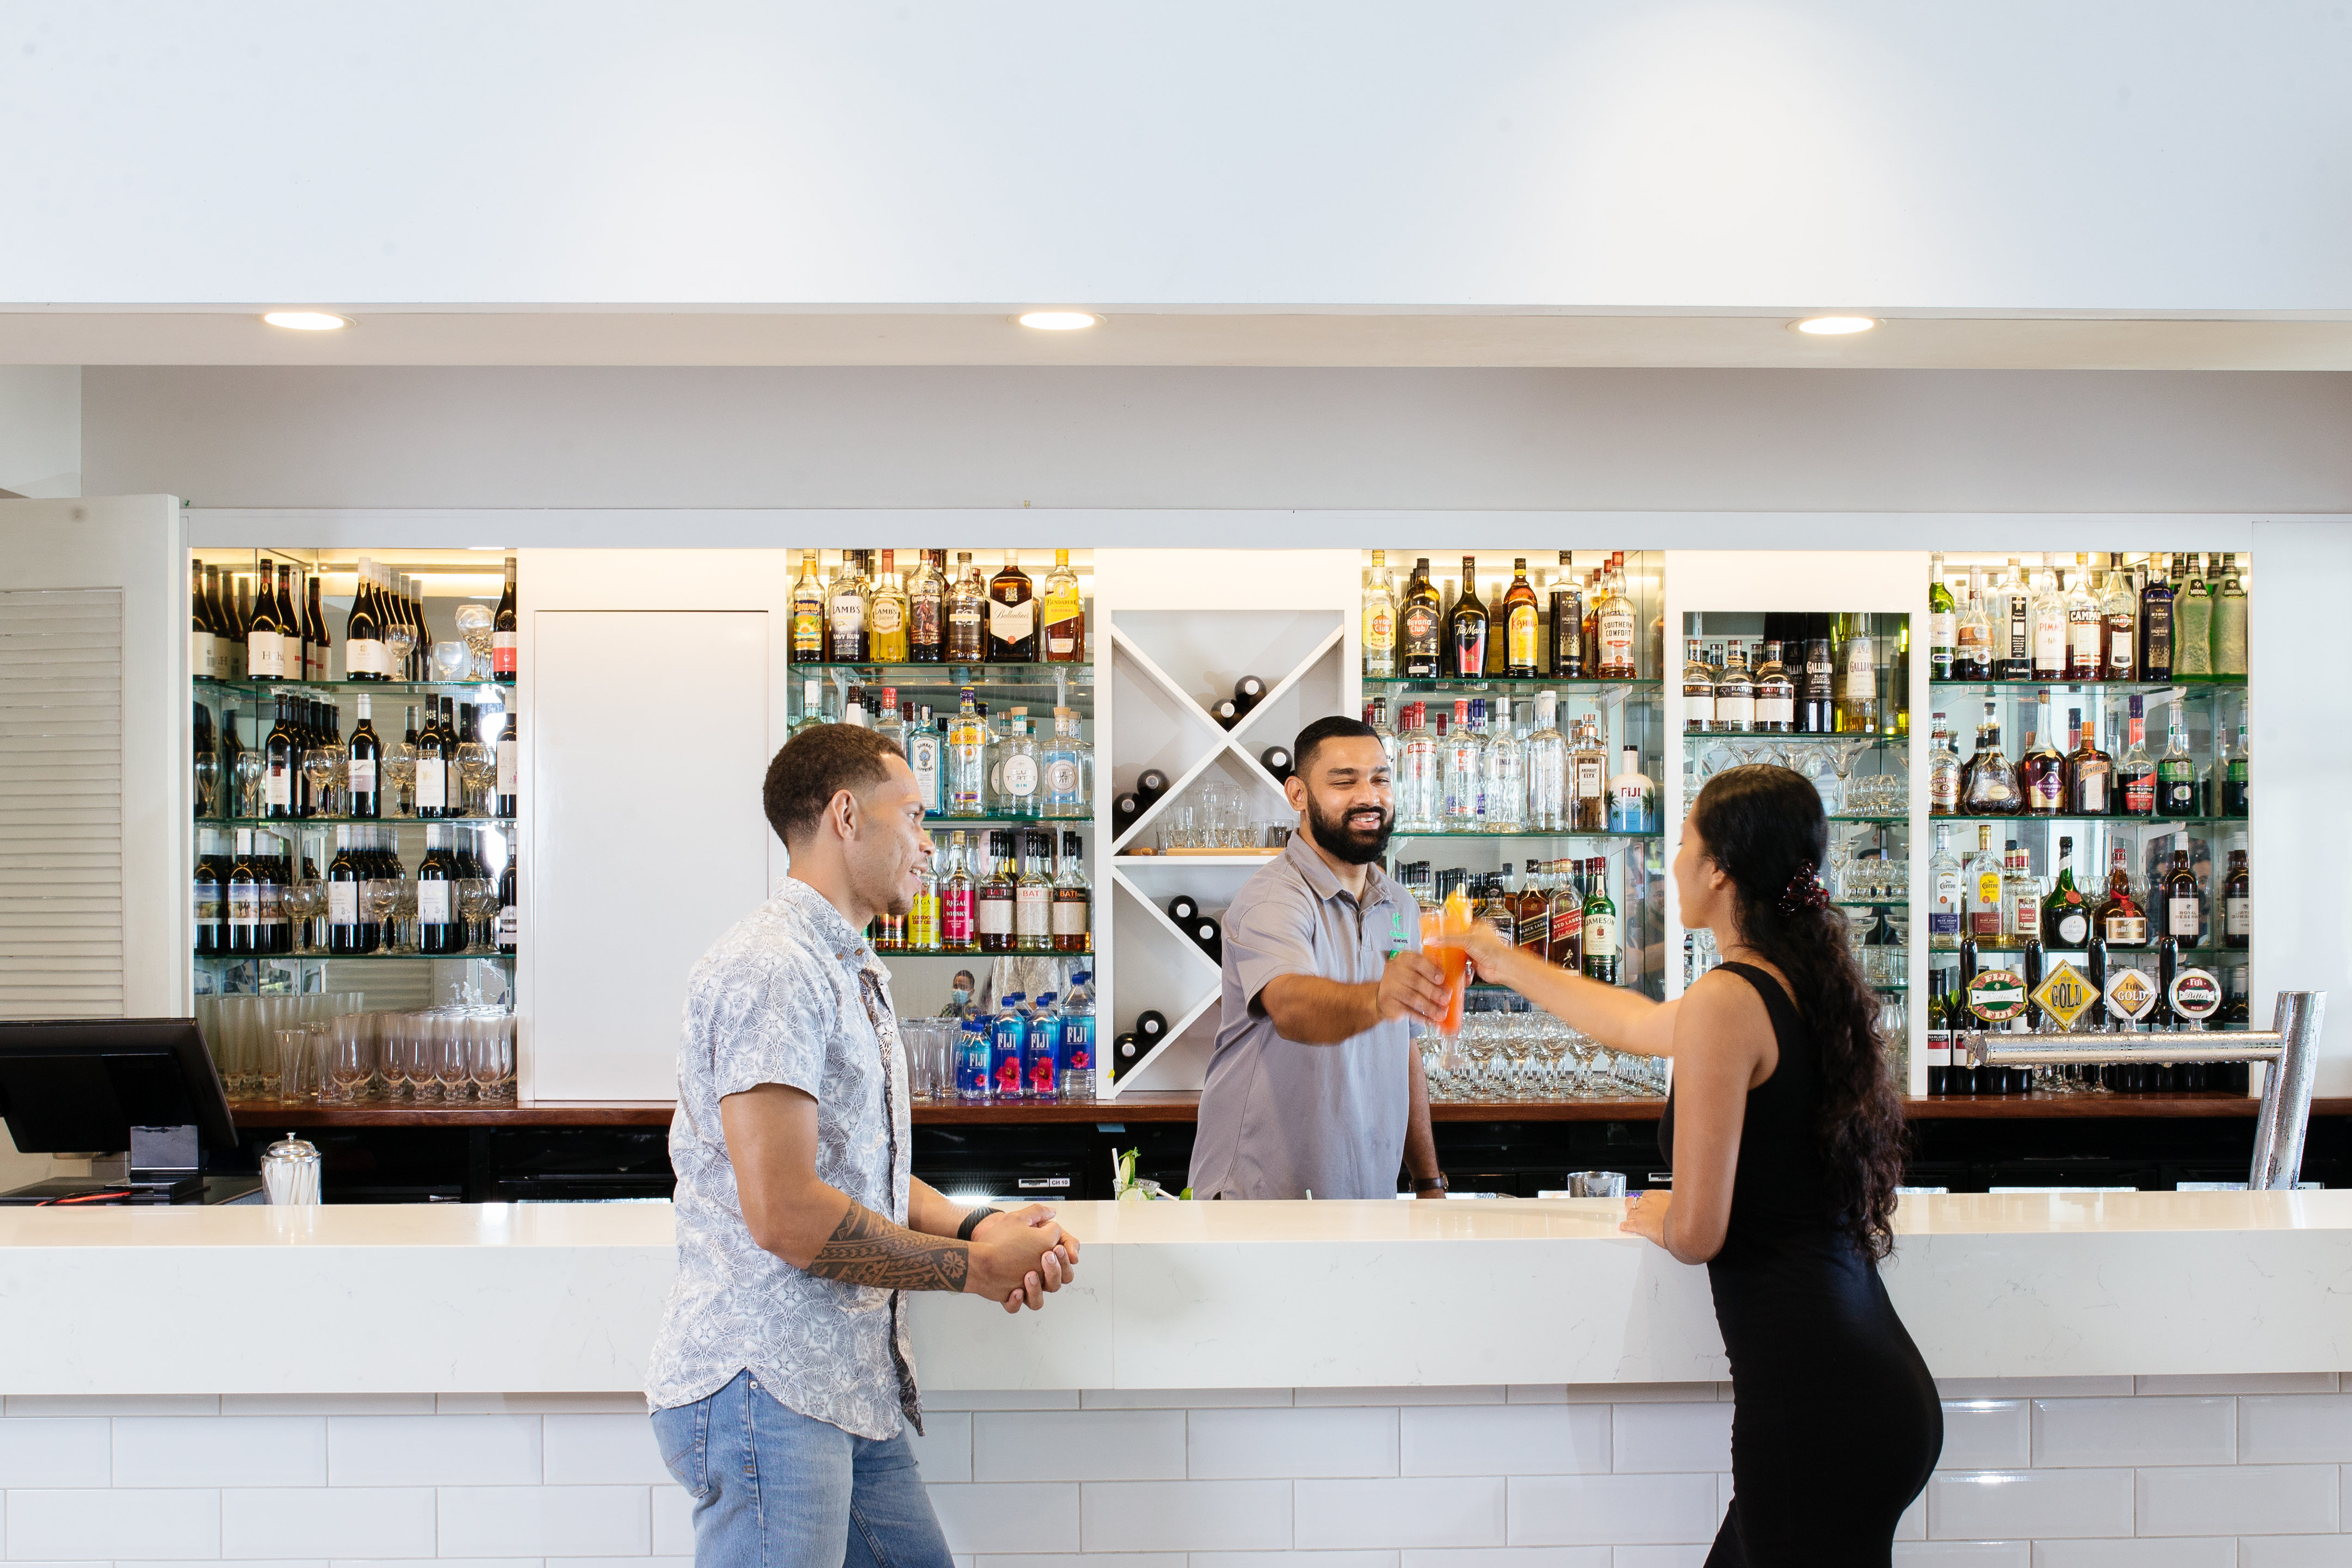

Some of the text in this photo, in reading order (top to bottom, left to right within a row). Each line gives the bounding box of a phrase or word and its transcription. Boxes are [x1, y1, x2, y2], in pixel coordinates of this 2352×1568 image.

[832, 605, 860, 614] LAMB'S
[994, 608, 1029, 619] Ballantine's
[1407, 618, 1432, 626] Havana
[1604, 621, 1632, 629] SOUTHERN
[2039, 621, 2064, 632] PIMM'S
[1415, 641, 1421, 650] 7
[1806, 661, 1833, 674] GALLIANO
[2082, 764, 2106, 777] COINTREAU
[1621, 787, 1640, 797] FIJI
[947, 899, 968, 908] REGAL
[1565, 917, 1582, 925] LABEL
[1585, 917, 1615, 926] JAMESON
[1984, 973, 2011, 983] FIJI
[2190, 978, 2203, 986] Fiji
[2051, 983, 2083, 1009] GOLD
[2117, 990, 2146, 1001] GOLD
[2184, 991, 2208, 999] Bitter
[1986, 1009, 2014, 1018] FIJI
[1066, 1027, 1088, 1044] FIJI
[997, 1033, 1017, 1049] FIJI
[1030, 1033, 1050, 1049] FIJI
[969, 1053, 987, 1067] FIJI
